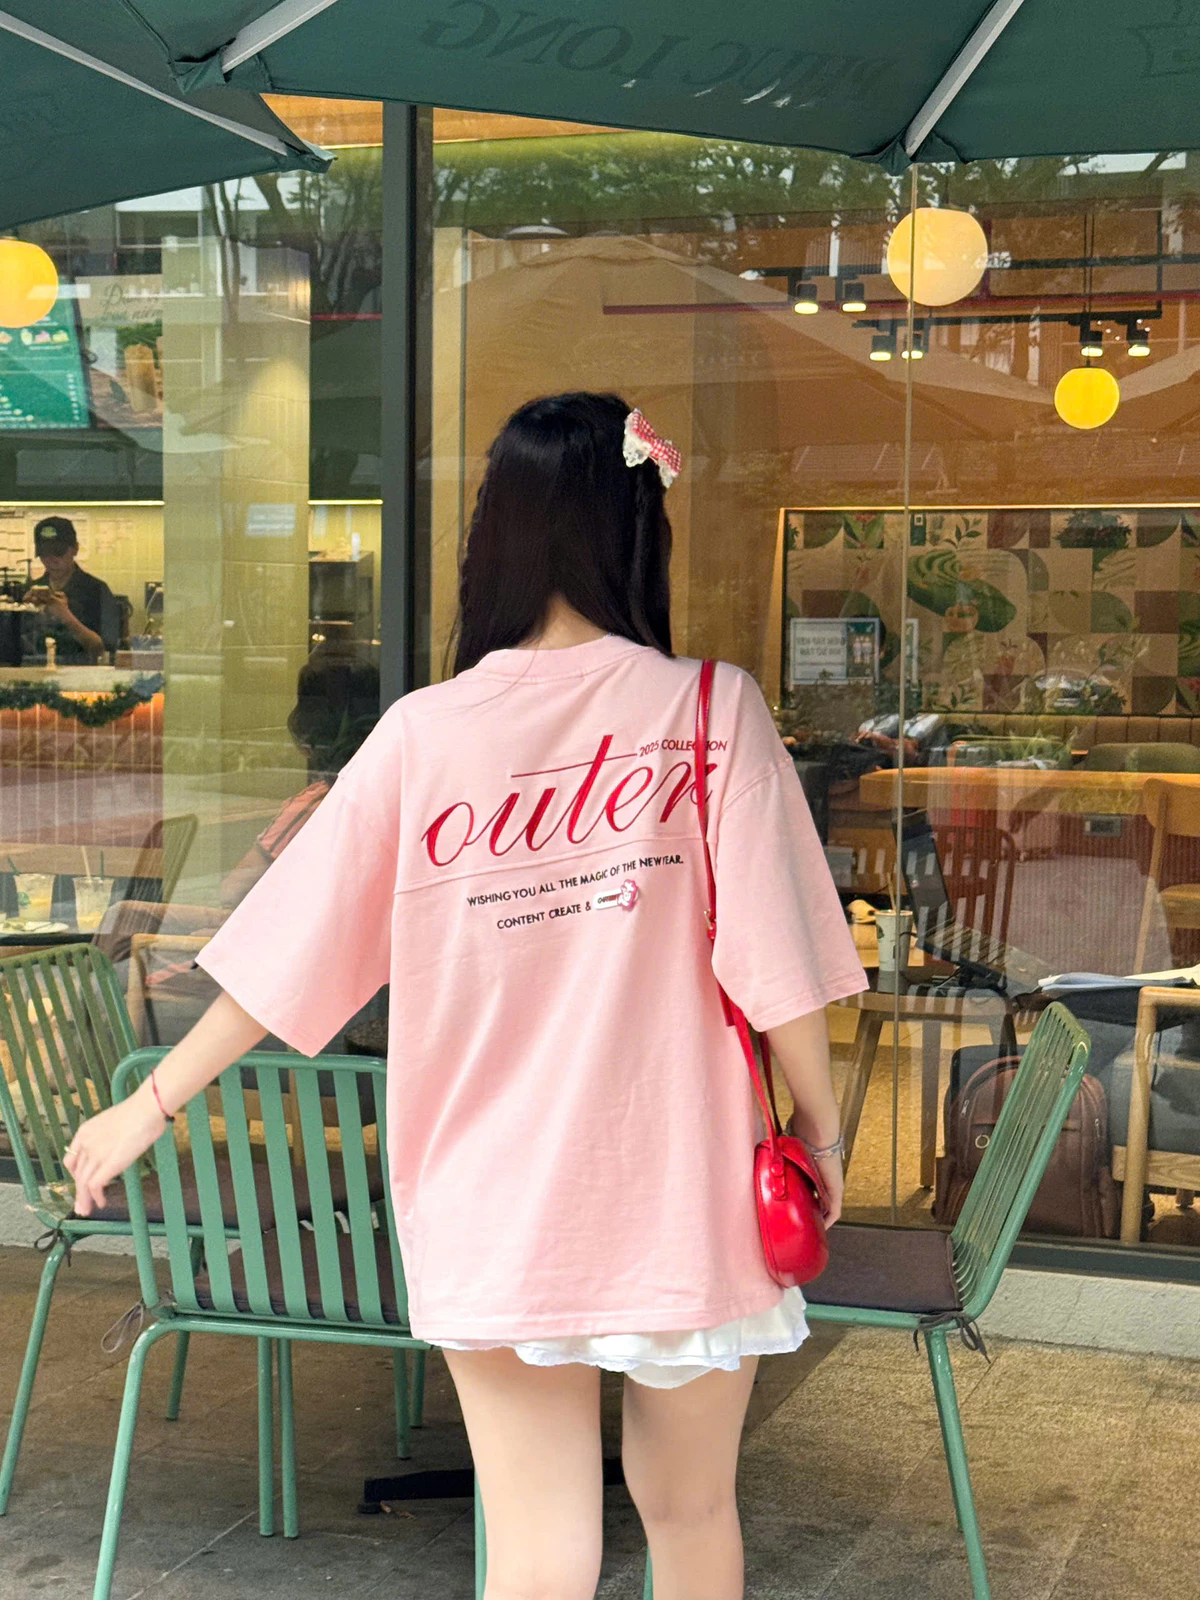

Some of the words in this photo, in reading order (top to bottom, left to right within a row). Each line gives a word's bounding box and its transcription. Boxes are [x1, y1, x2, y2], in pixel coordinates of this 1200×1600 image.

[640, 740, 659, 757] 2025
[661, 739, 728, 752] COLLEION
[467, 891, 511, 907] WISHING
[512, 887, 536, 899] YOU
[539, 882, 556, 895] ALL
[559, 877, 578, 889] THE
[580, 869, 608, 885] MAGIC
[610, 865, 620, 877] OF
[622, 860, 637, 872] THE
[497, 912, 545, 929] CONTENT
[549, 904, 581, 919] CREATE
[585, 901, 591, 911] &
